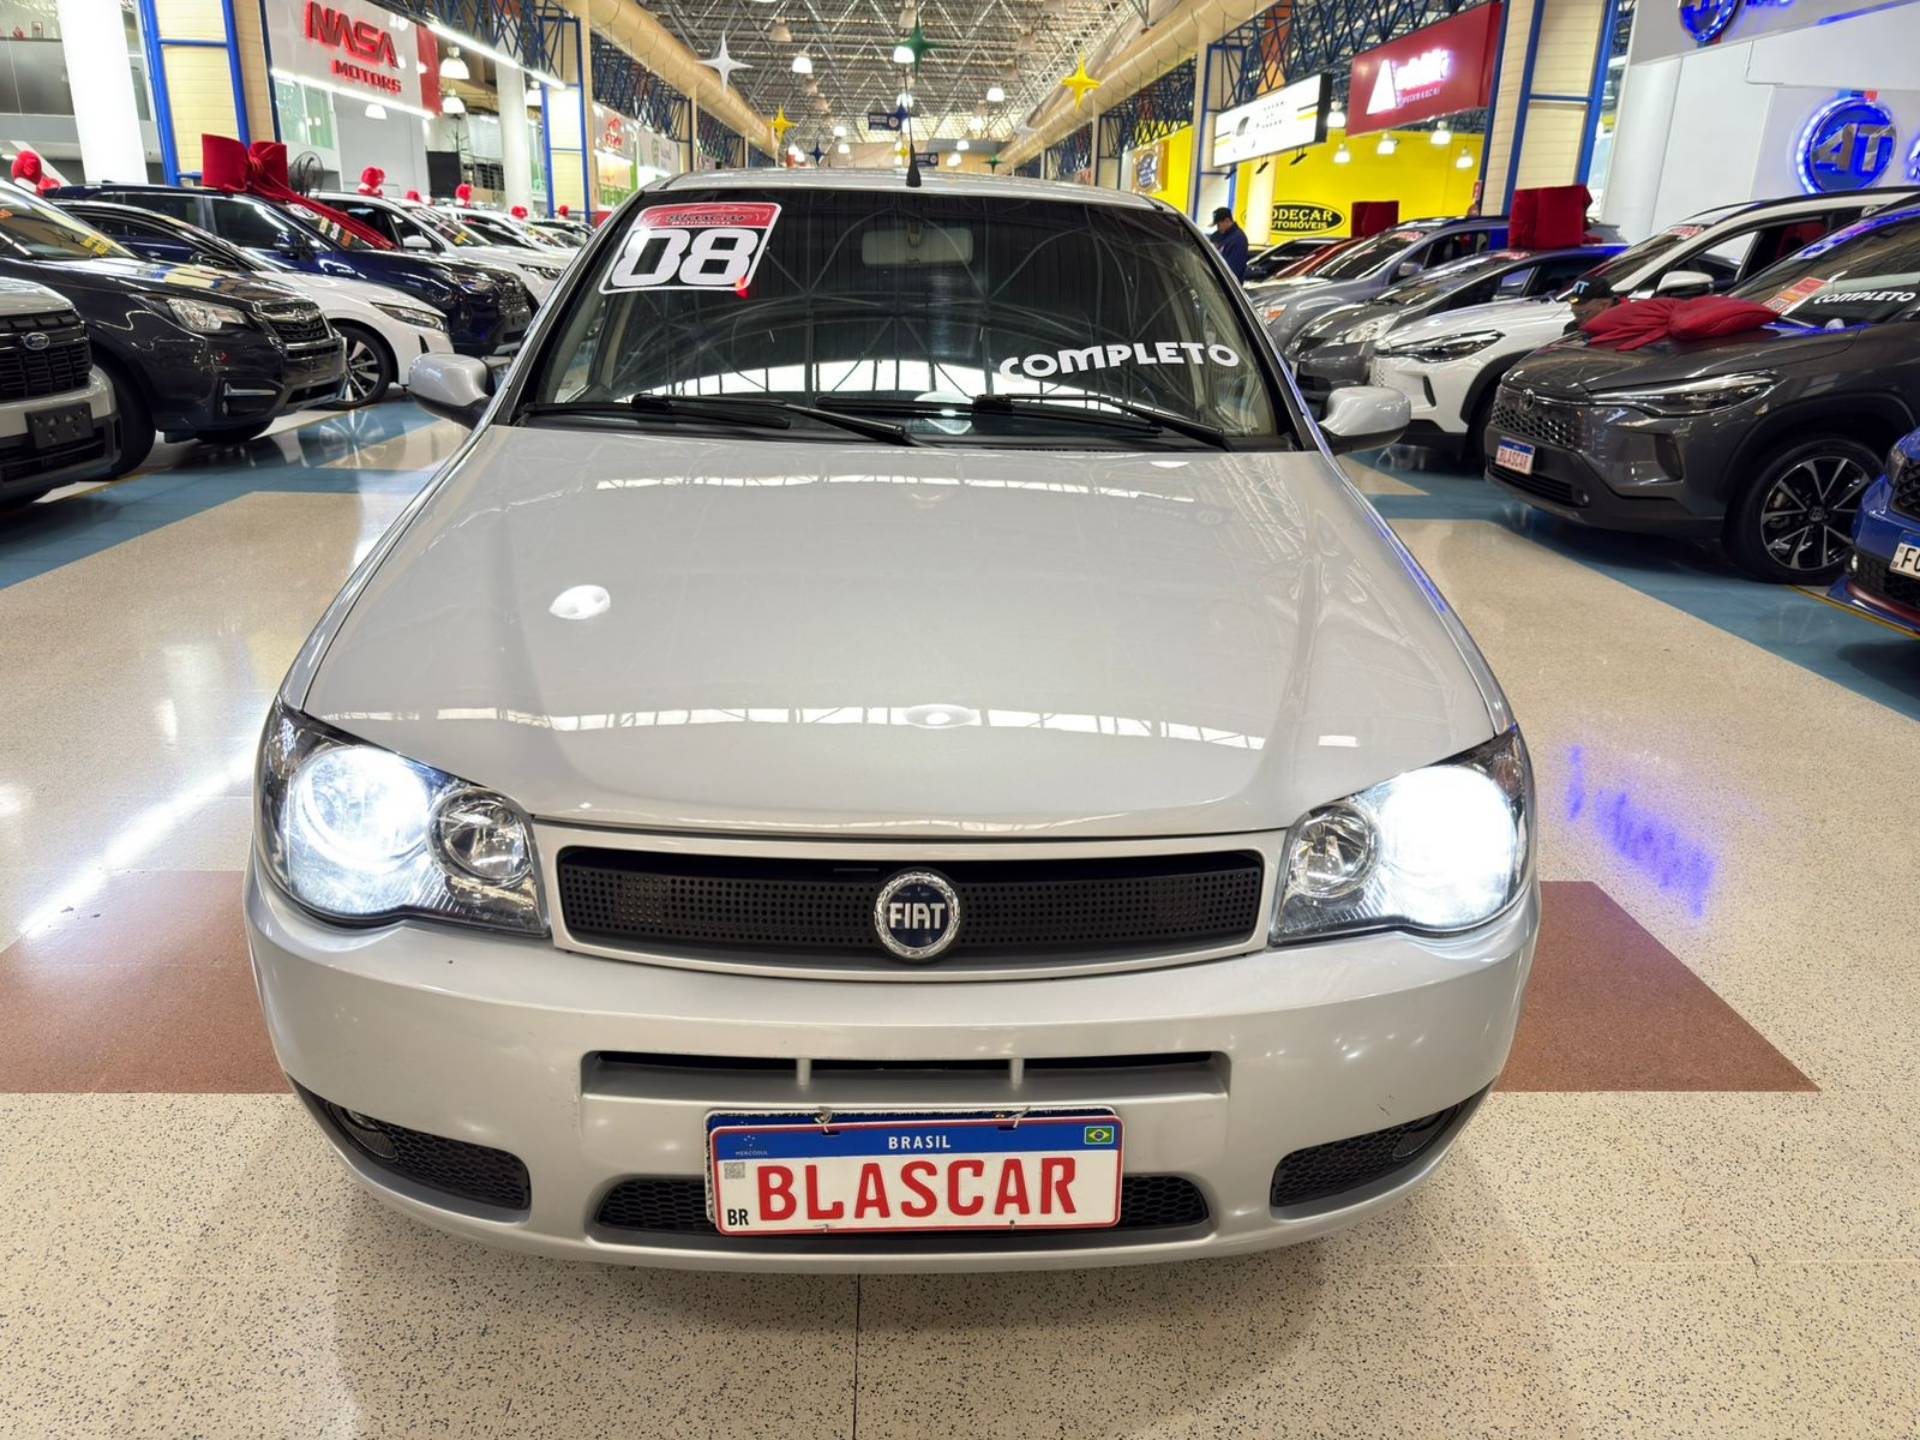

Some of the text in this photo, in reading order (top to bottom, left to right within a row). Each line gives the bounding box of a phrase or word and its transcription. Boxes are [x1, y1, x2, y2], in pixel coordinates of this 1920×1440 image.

[305, 1, 399, 68] NASA
[332, 60, 401, 93] MOTORS
[1812, 122, 1896, 172] AT
[1271, 209, 1333, 221] ODECAR
[1271, 220, 1328, 229] UTOMÓVEIS
[611, 228, 758, 287] 08
[1814, 291, 1916, 305] COMPLETO
[999, 342, 1240, 383] COMPLETO
[889, 902, 946, 929] FIAT
[888, 1135, 951, 1150] BRASIL
[757, 1157, 1076, 1221] BLASCAR
[727, 1208, 749, 1226] BR
